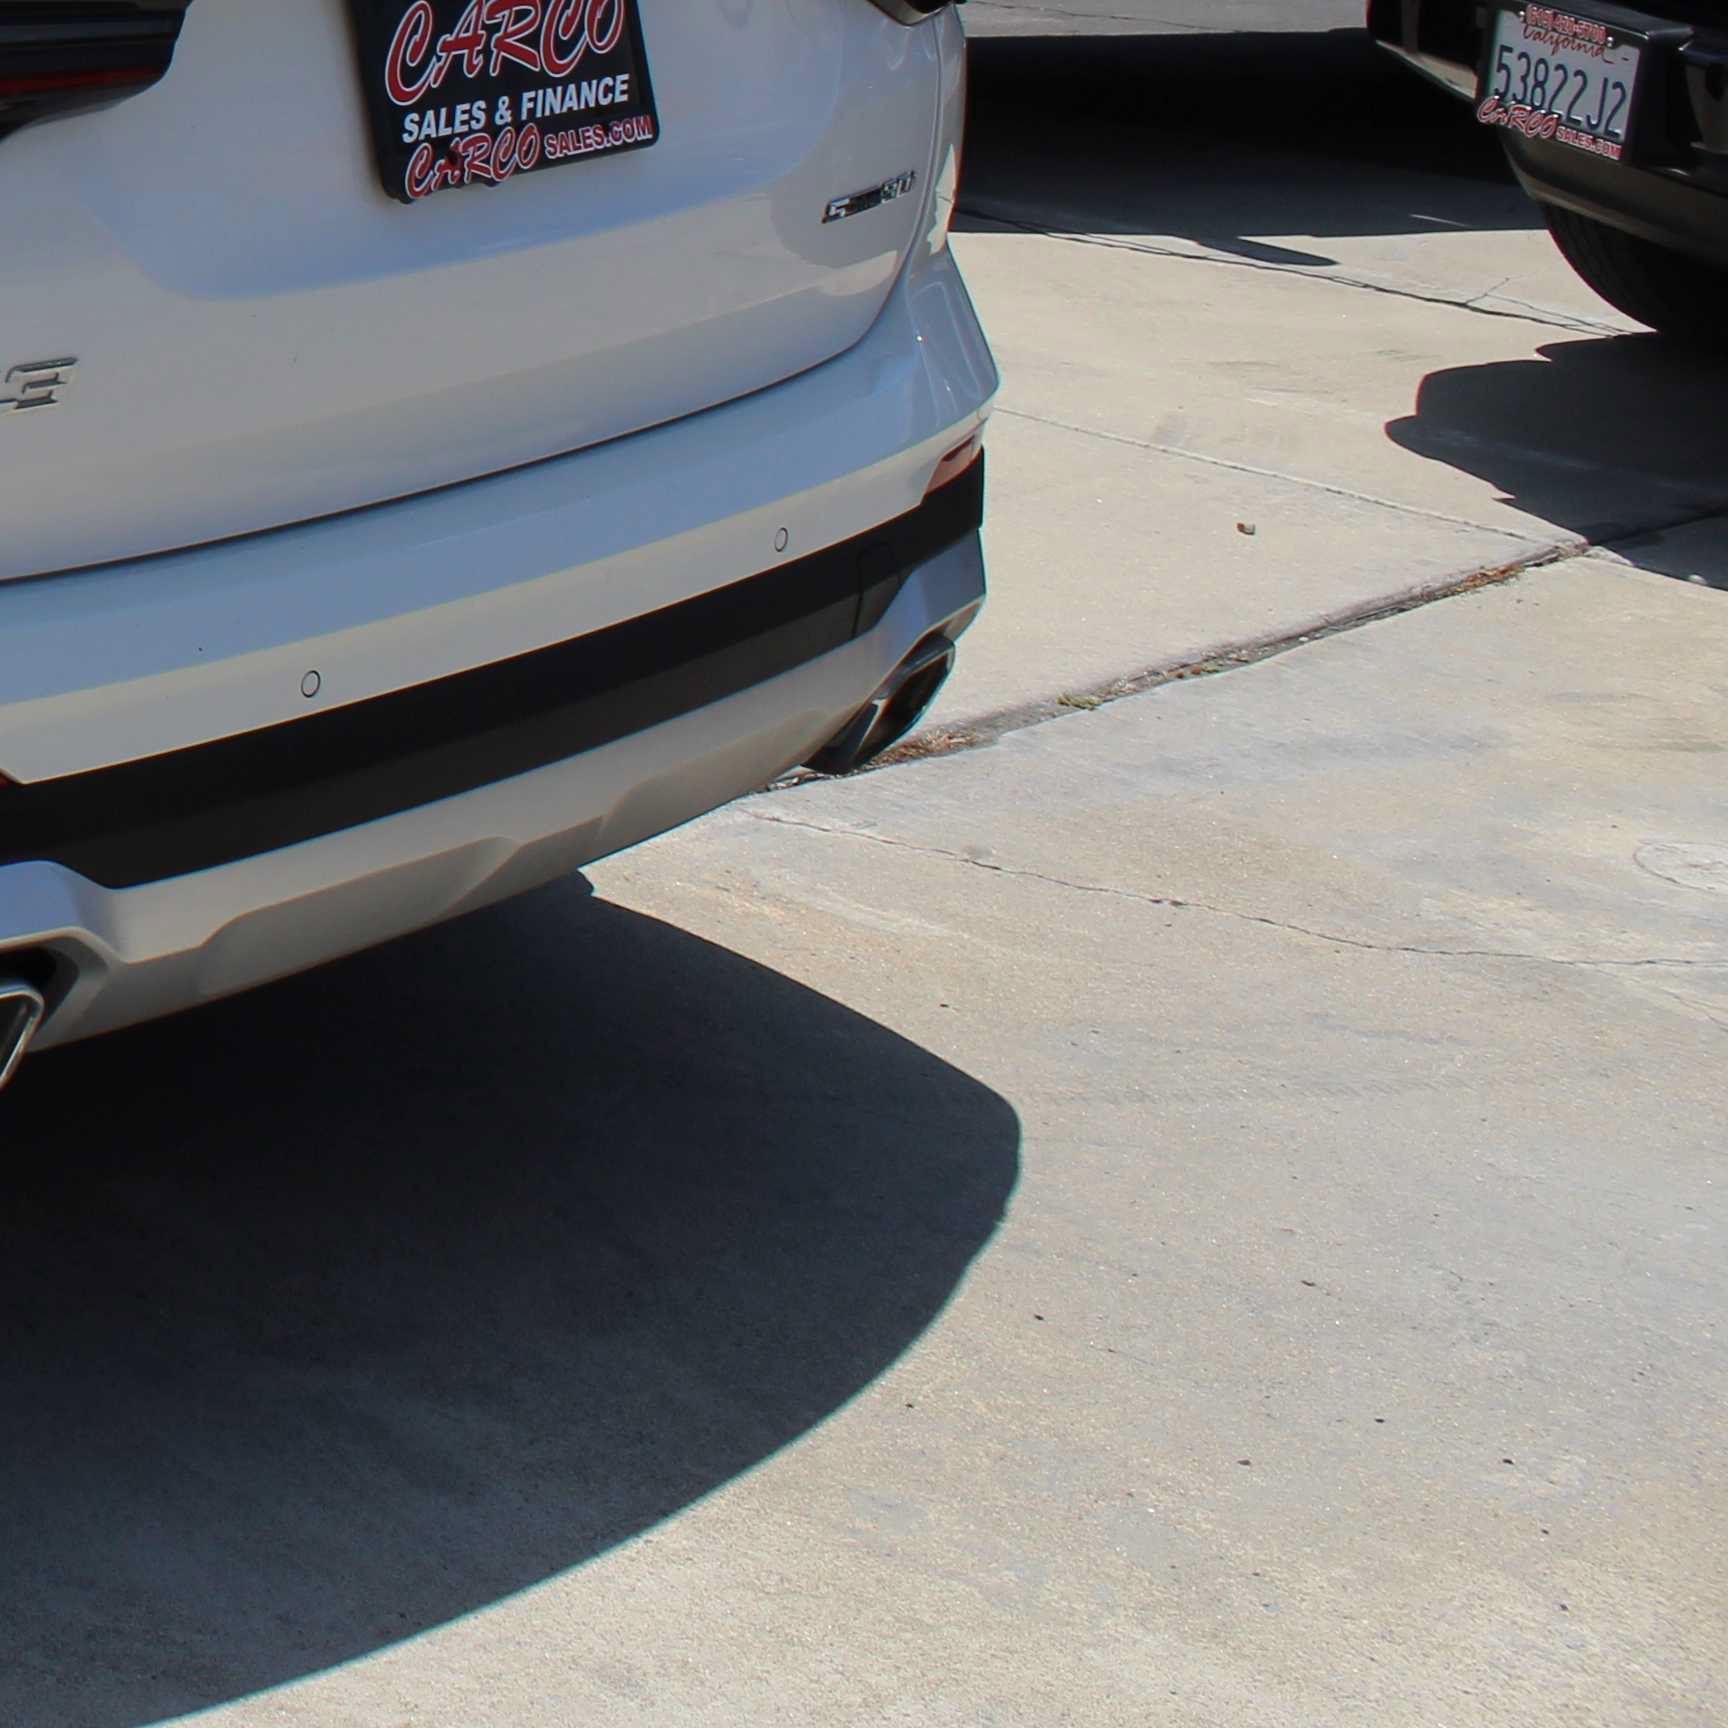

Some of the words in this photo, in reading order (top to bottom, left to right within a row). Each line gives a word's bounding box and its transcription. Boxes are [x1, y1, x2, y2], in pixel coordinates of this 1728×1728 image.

[402, 100, 487, 143] SALES
[495, 96, 512, 125] &
[521, 73, 630, 120] FINANCE
[1495, 44, 1626, 138] 53822J2
